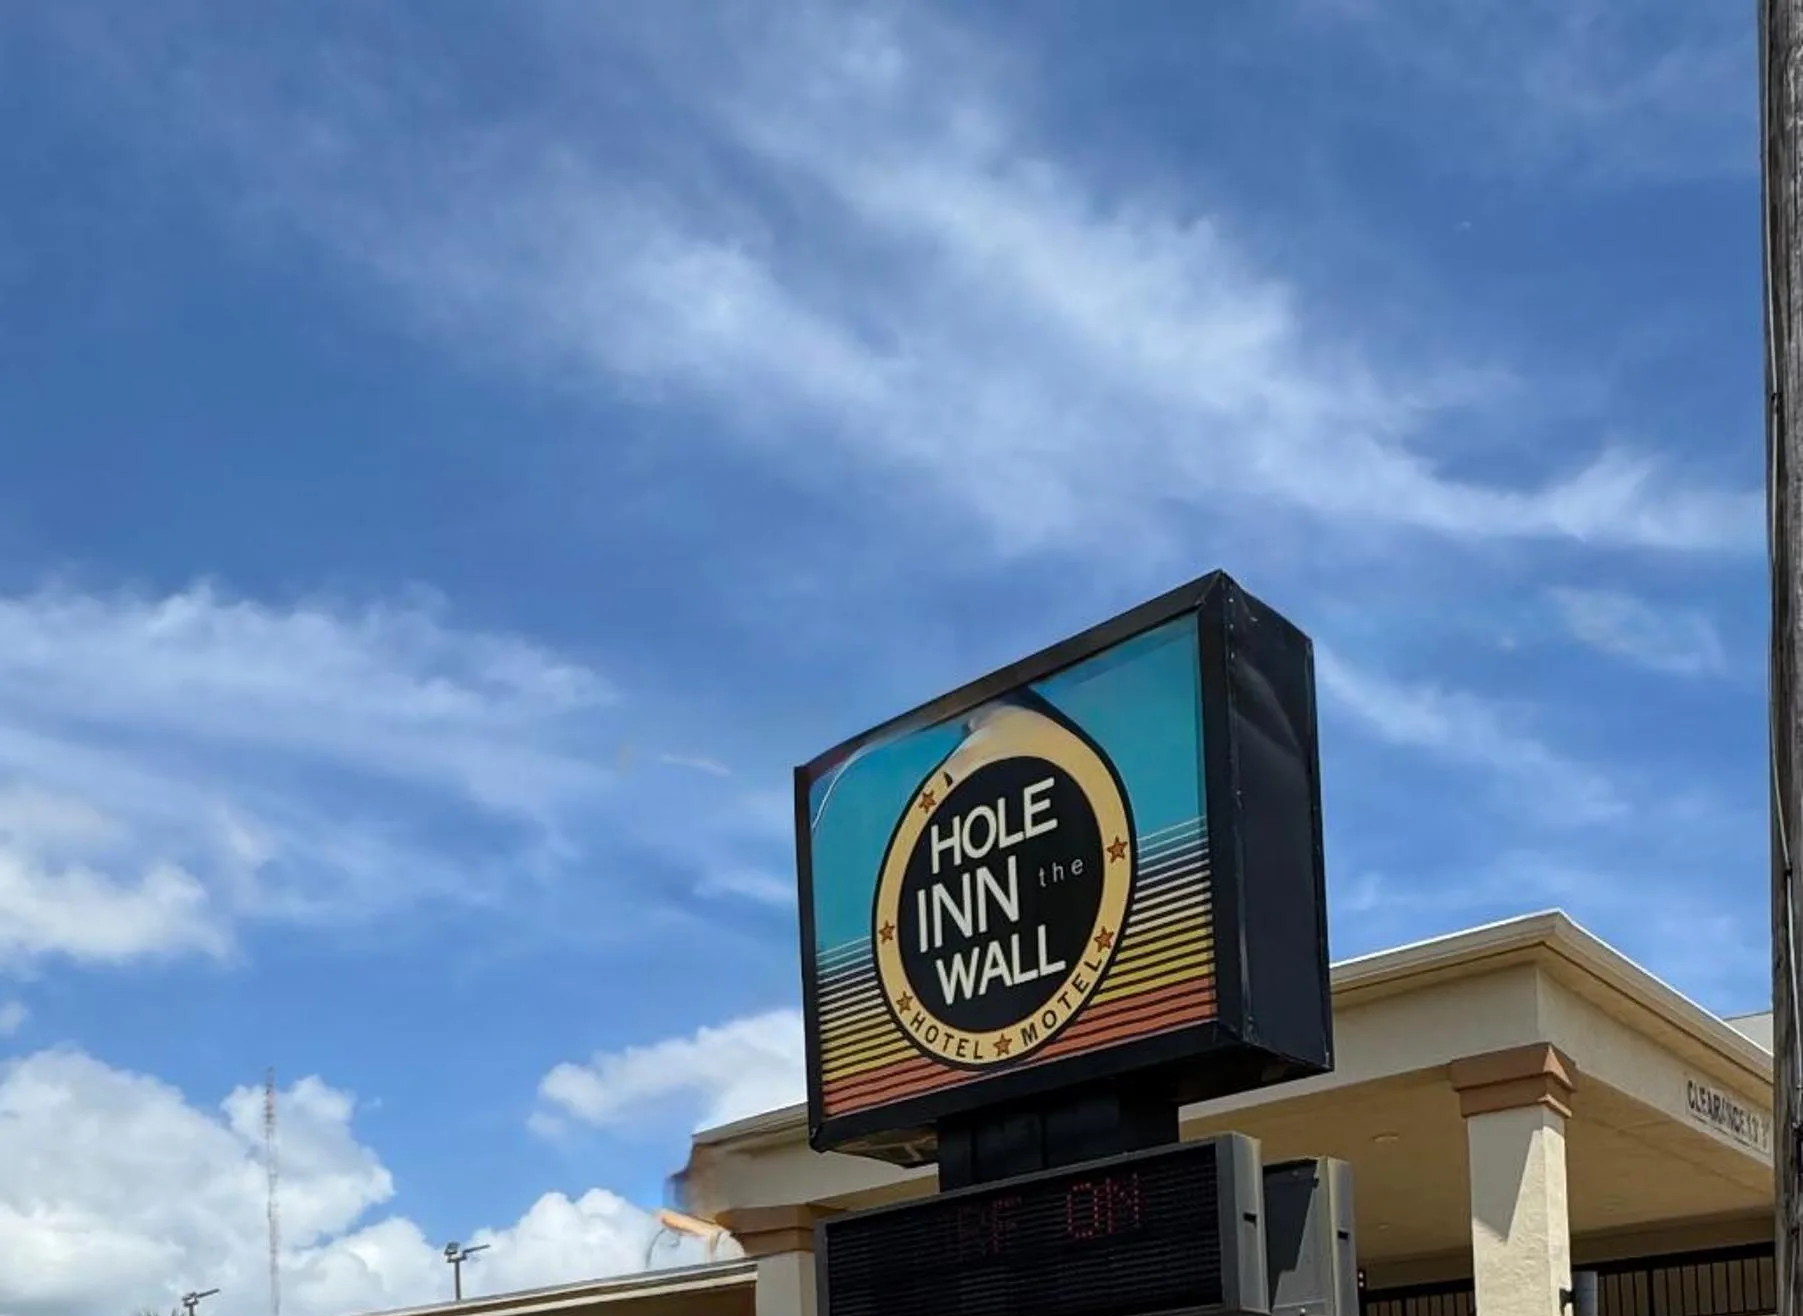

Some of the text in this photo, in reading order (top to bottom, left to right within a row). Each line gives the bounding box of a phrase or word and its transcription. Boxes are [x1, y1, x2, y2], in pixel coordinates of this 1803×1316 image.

[929, 776, 1058, 874] HOLE
[916, 855, 1084, 953] INN the
[909, 958, 1103, 1061] HOTEL MOTEL
[935, 925, 1067, 1006] WALL
